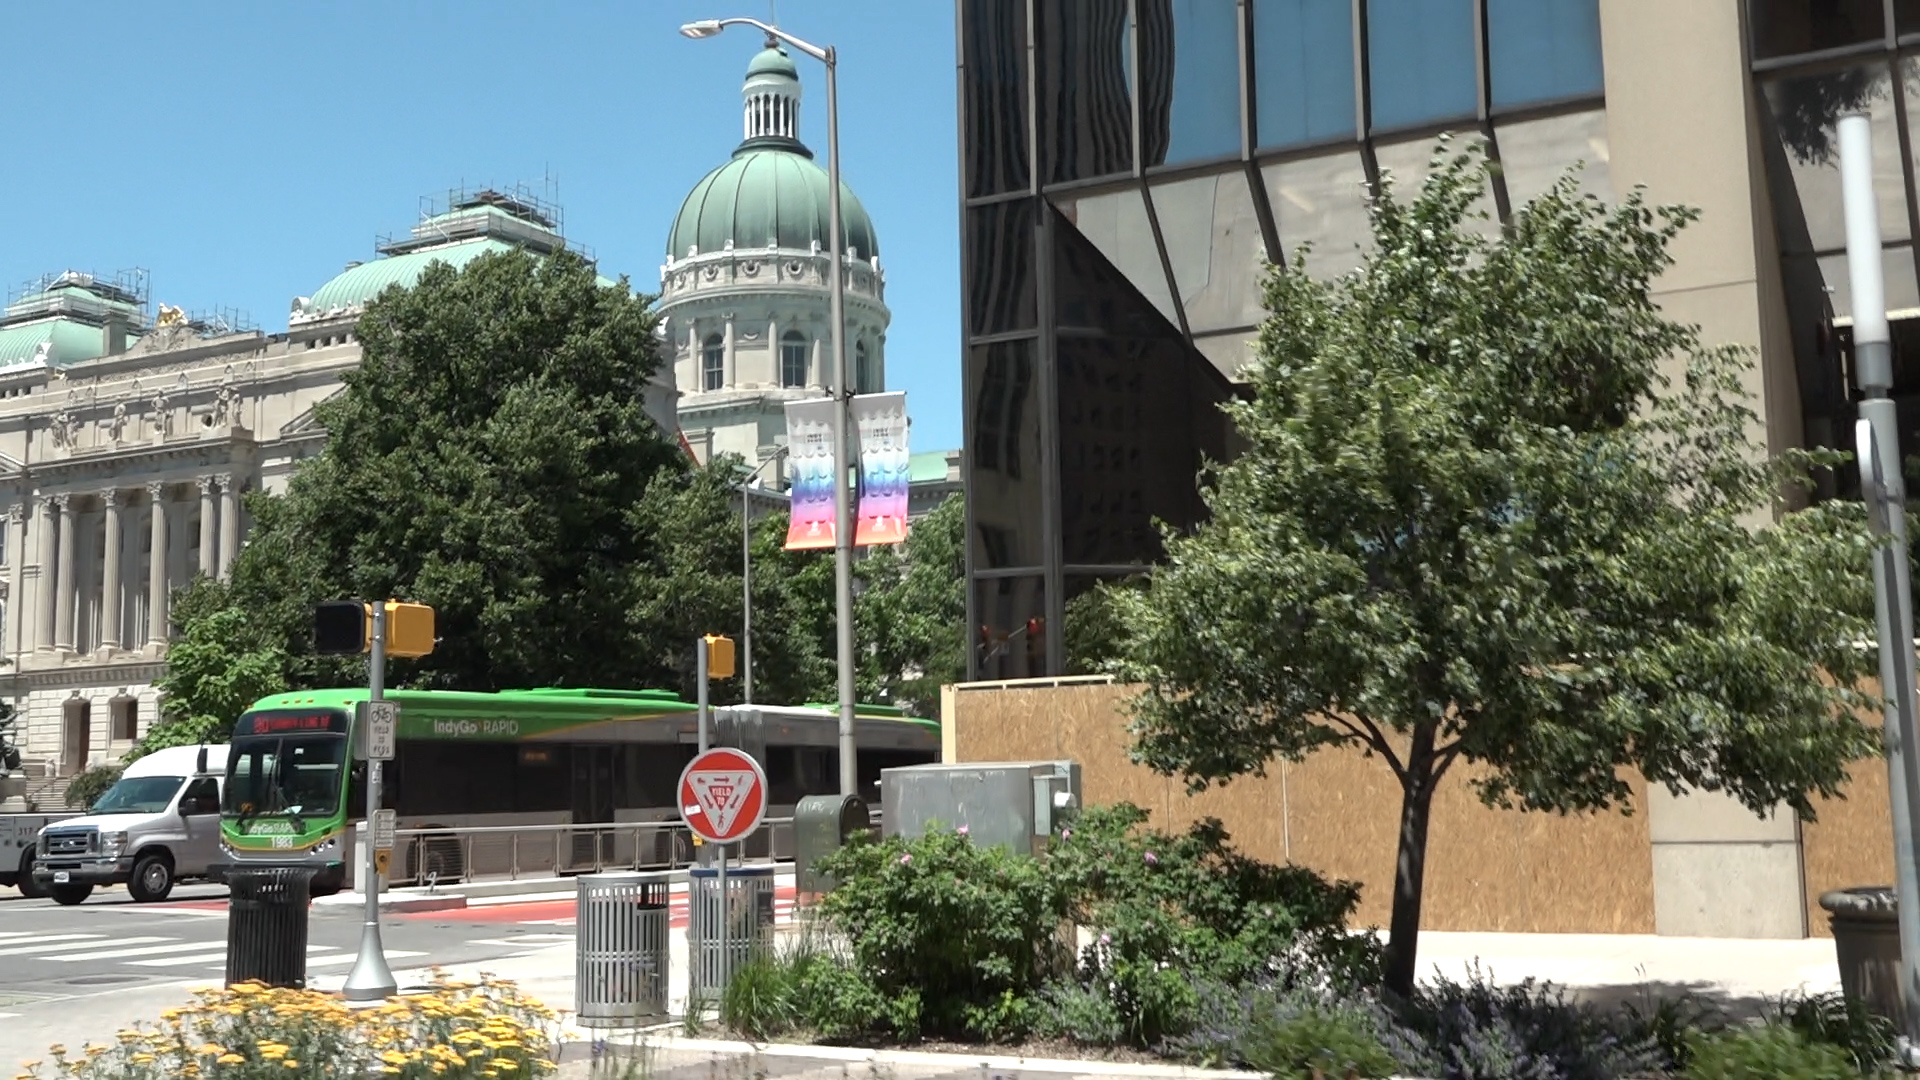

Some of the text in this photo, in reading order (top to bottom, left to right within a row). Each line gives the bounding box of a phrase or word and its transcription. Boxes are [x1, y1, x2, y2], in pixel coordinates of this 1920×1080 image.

[434, 719, 519, 737] IndyGo RAPID
[711, 787, 732, 796] YIELD
[717, 796, 725, 805] TO
[271, 837, 294, 849] 1983
